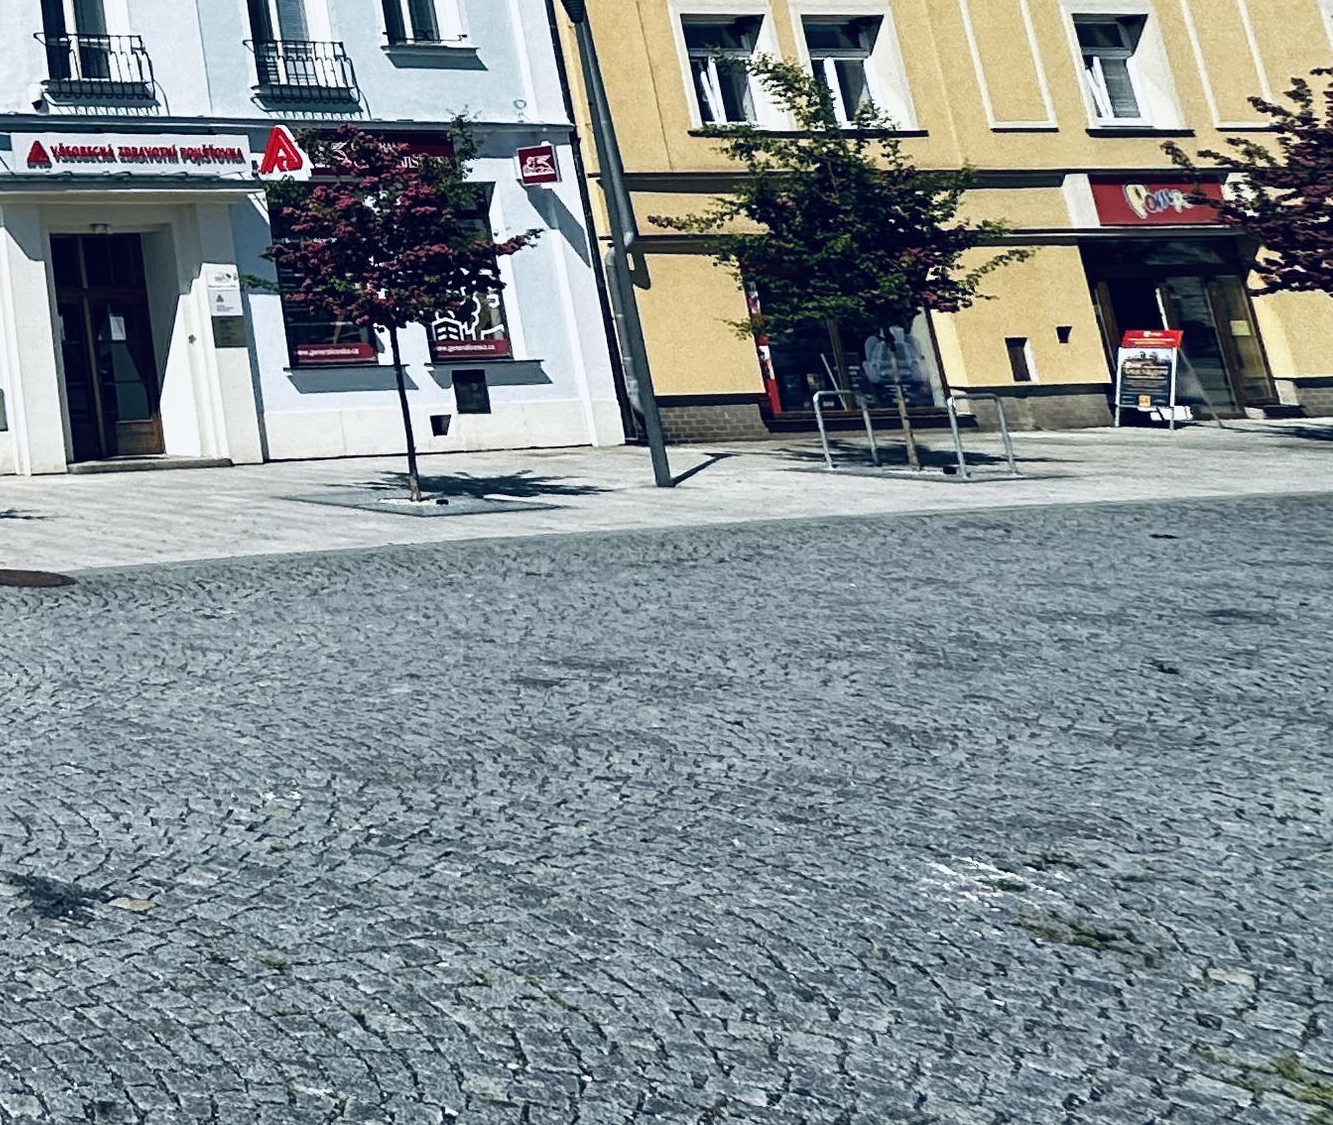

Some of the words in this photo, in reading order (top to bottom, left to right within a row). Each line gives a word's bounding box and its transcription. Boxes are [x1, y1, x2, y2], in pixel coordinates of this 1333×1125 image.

[50, 143, 117, 163] VŠEOBECNÁ
[117, 144, 179, 164] ZDRAVOTNÍ
[179, 144, 246, 166] POJIŠŤOVNA
